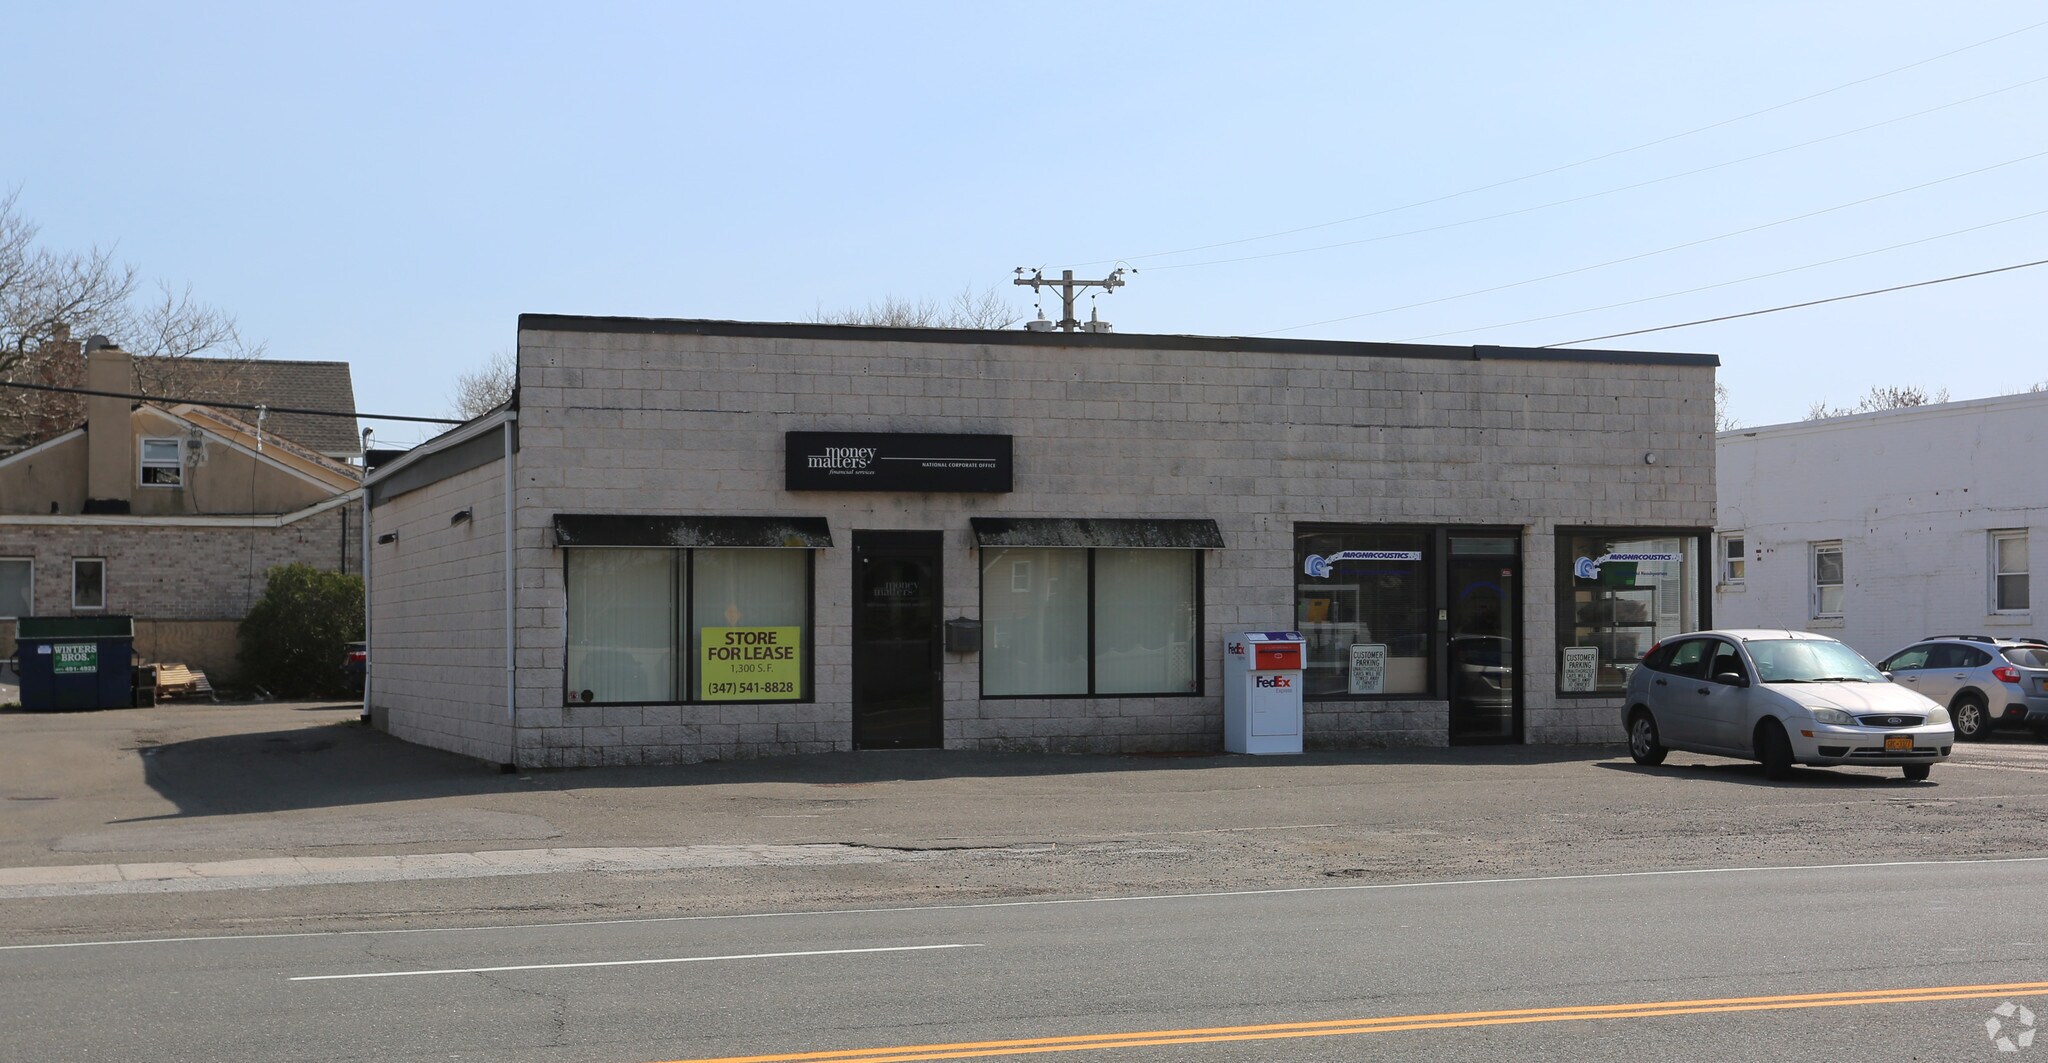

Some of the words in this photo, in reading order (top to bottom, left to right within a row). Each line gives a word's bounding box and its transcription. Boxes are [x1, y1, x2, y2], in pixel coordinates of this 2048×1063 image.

[808, 456, 867, 468] matters
[825, 447, 877, 464] money
[1342, 551, 1409, 559] MAGNACOUSTICS
[725, 631, 777, 645] STORE
[54, 645, 97, 654] WINTERS
[708, 647, 741, 661] FOR
[744, 646, 794, 660] LEASE
[1228, 642, 1245, 655] FedEx
[61, 653, 90, 662] BROS.
[731, 664, 755, 673] 1,300
[1256, 675, 1291, 688] FedEx
[708, 682, 737, 695] (347)
[739, 682, 794, 693] 541-8828
